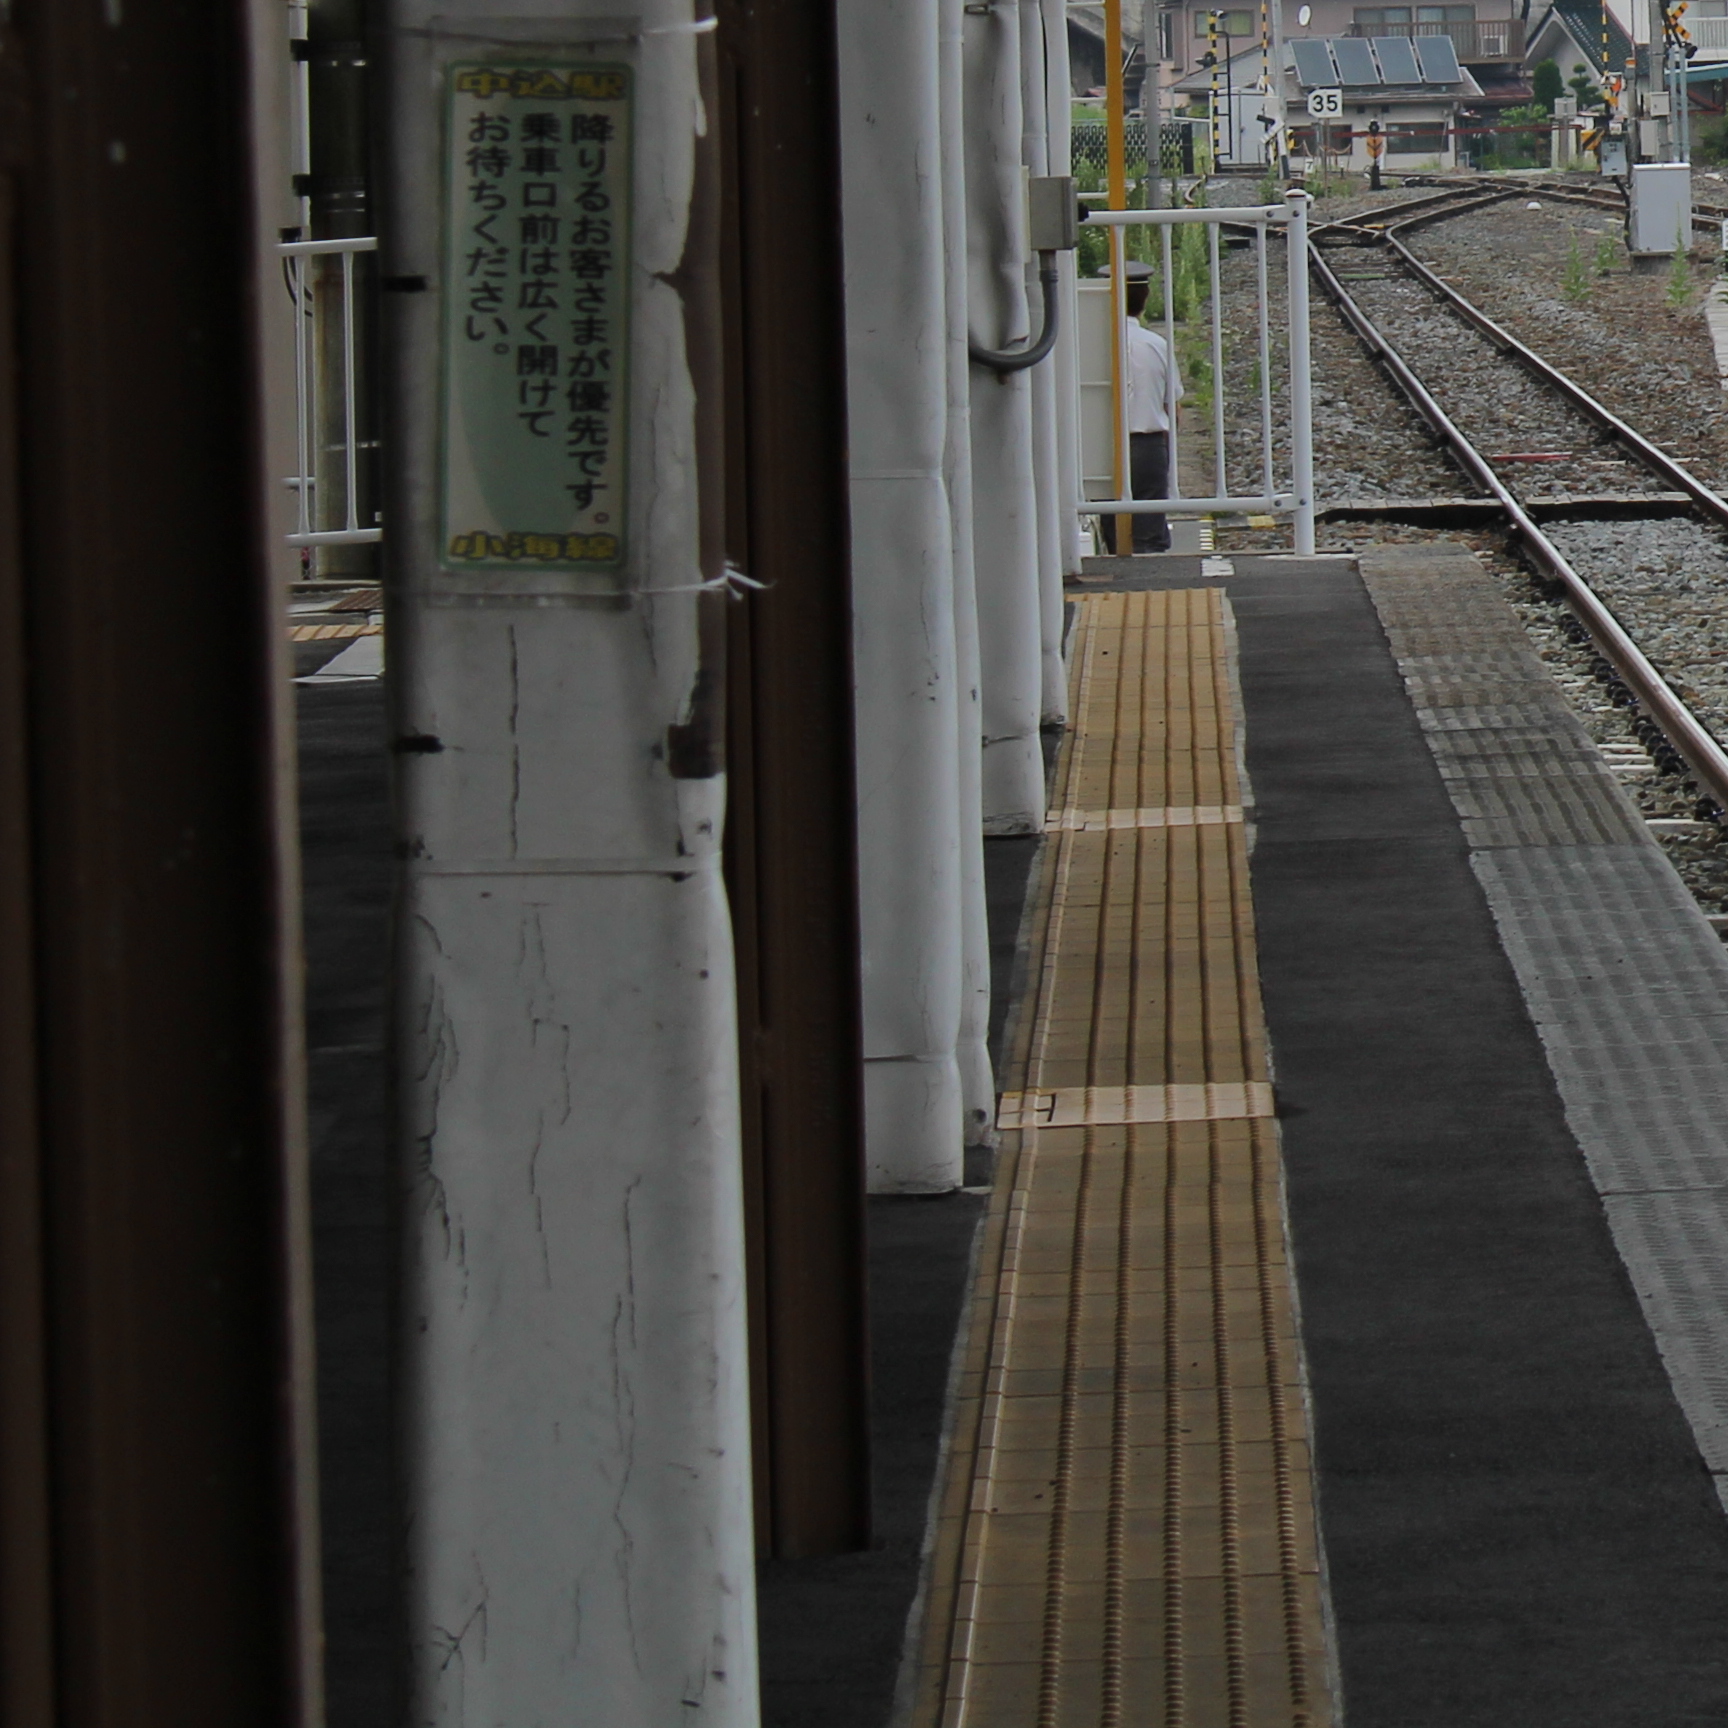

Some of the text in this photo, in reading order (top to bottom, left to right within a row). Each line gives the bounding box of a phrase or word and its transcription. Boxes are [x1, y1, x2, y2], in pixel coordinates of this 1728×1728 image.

[457, 68, 627, 101] 中込駅
[1312, 93, 1338, 113] 35
[464, 112, 511, 358] お待ちください。
[516, 112, 562, 439] 乗車口前は広く開けて
[566, 113, 614, 527] 降りるお客さまが優先です。
[449, 532, 619, 561] 小海線
